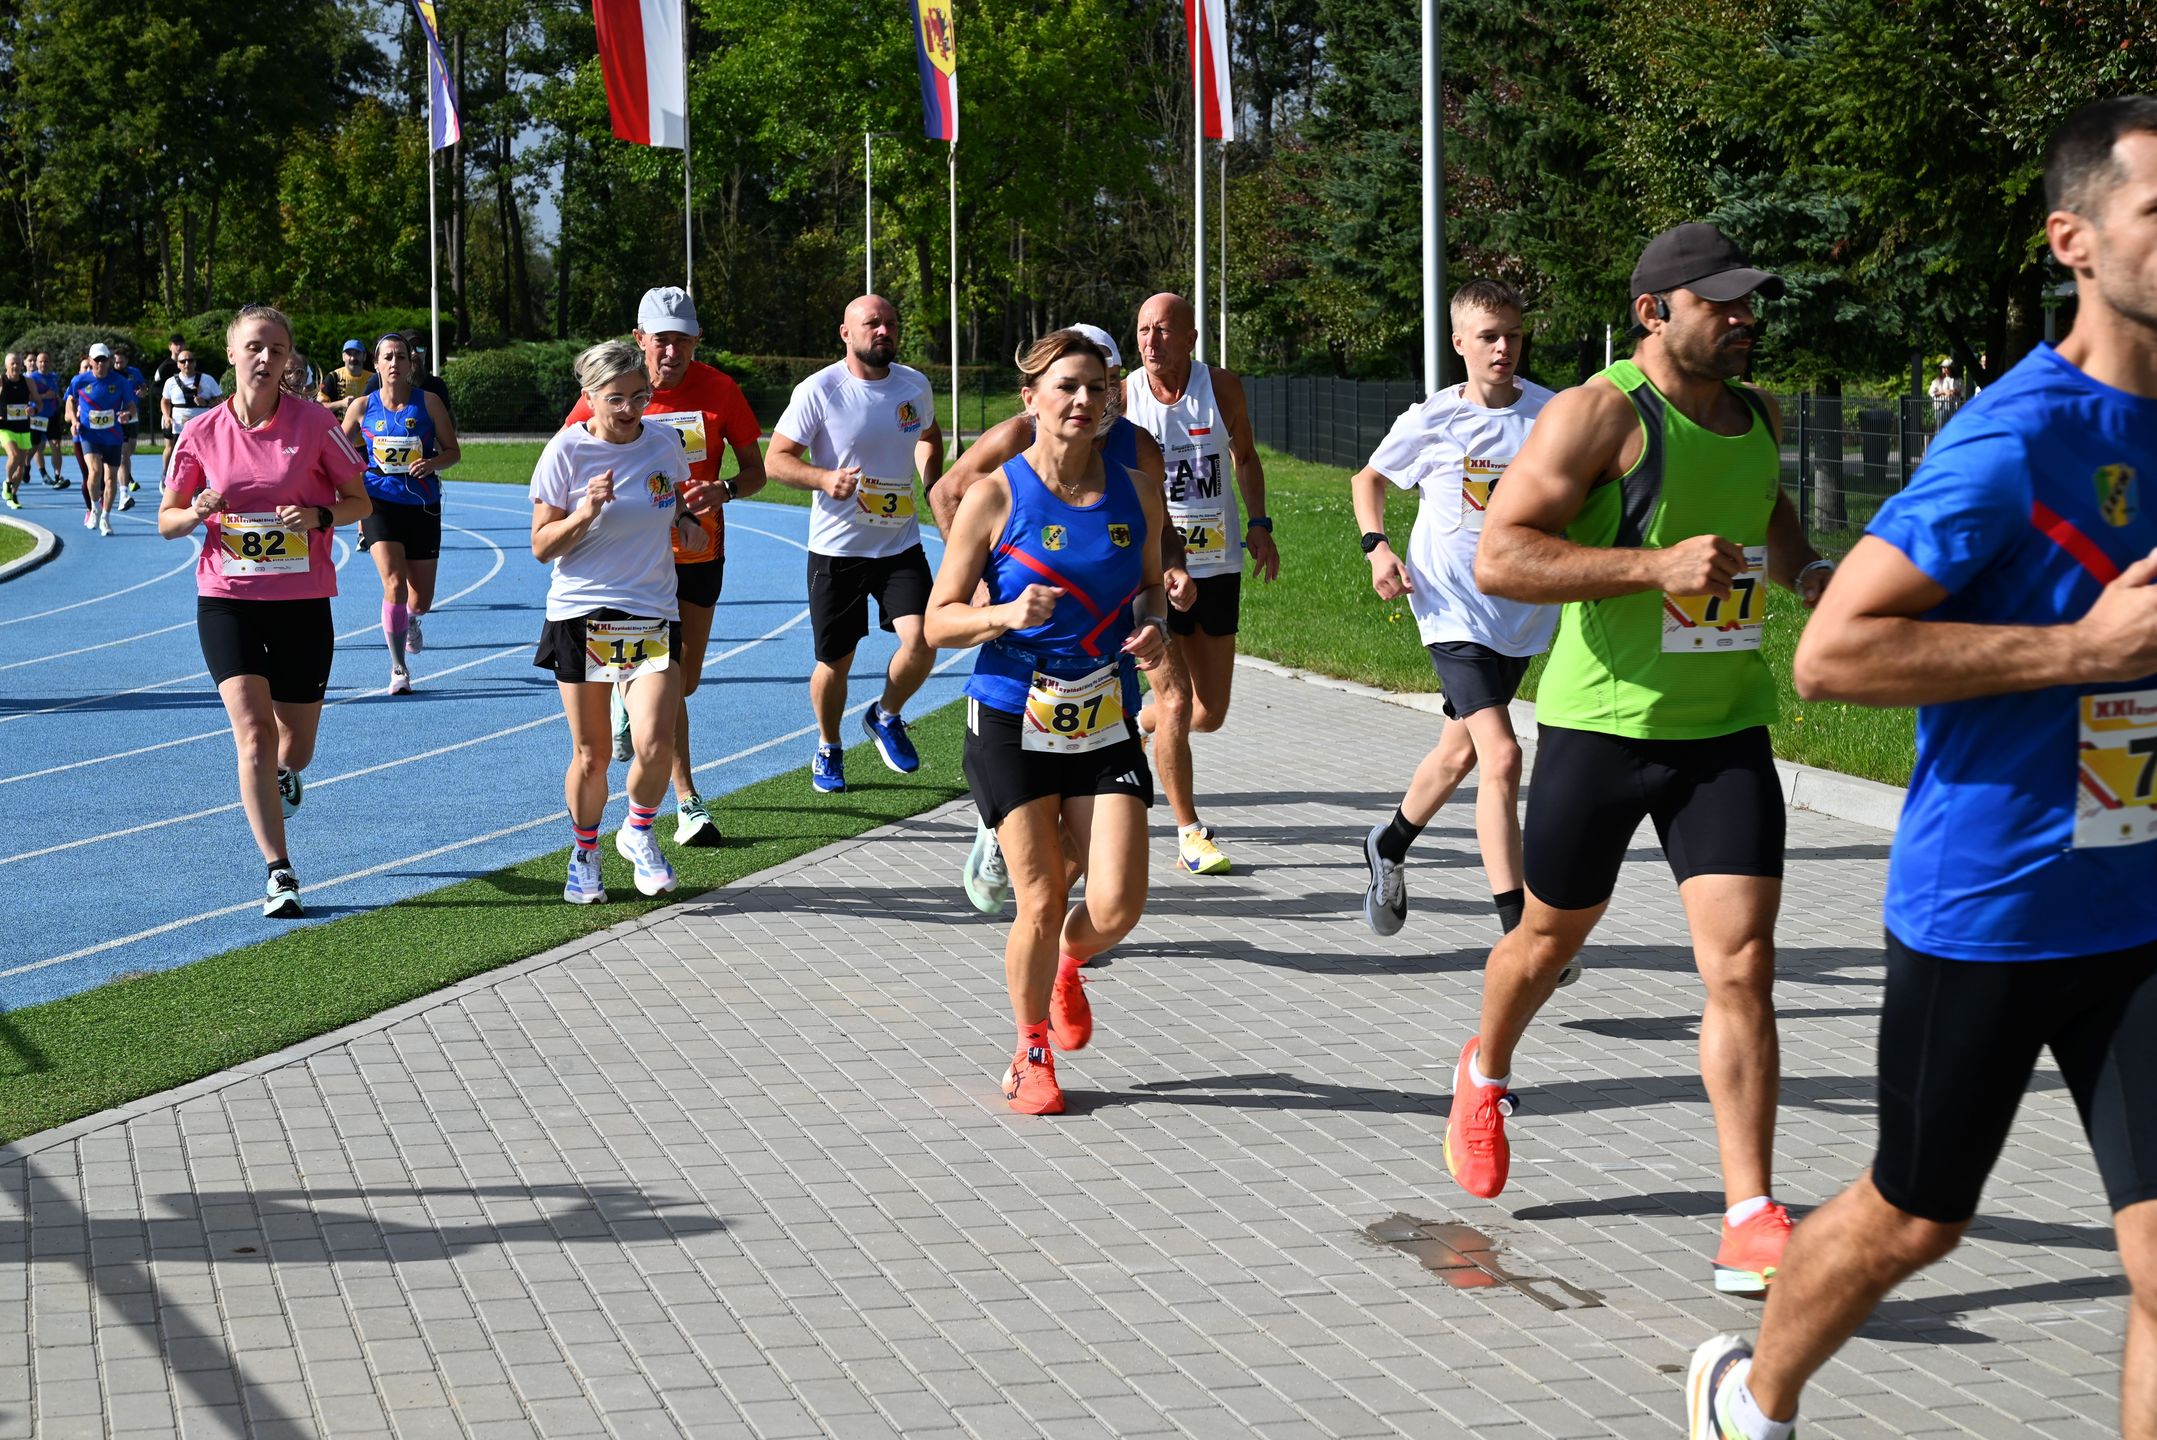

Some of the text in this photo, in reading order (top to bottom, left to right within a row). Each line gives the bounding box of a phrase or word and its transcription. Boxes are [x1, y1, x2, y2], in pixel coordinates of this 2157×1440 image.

[95, 416, 109, 424] 70
[385, 447, 411, 463] 27
[1471, 459, 1490, 468] XXI
[1164, 453, 1220, 482] TART
[865, 477, 880, 485] XXI
[882, 492, 898, 513] 3
[241, 530, 286, 557] 82
[1045, 527, 1063, 547] LECH
[594, 623, 611, 631] XXI
[609, 638, 648, 664] 11
[1039, 676, 1060, 691] XXI
[1052, 693, 1104, 733] 87
[2095, 699, 2135, 718] XXI
